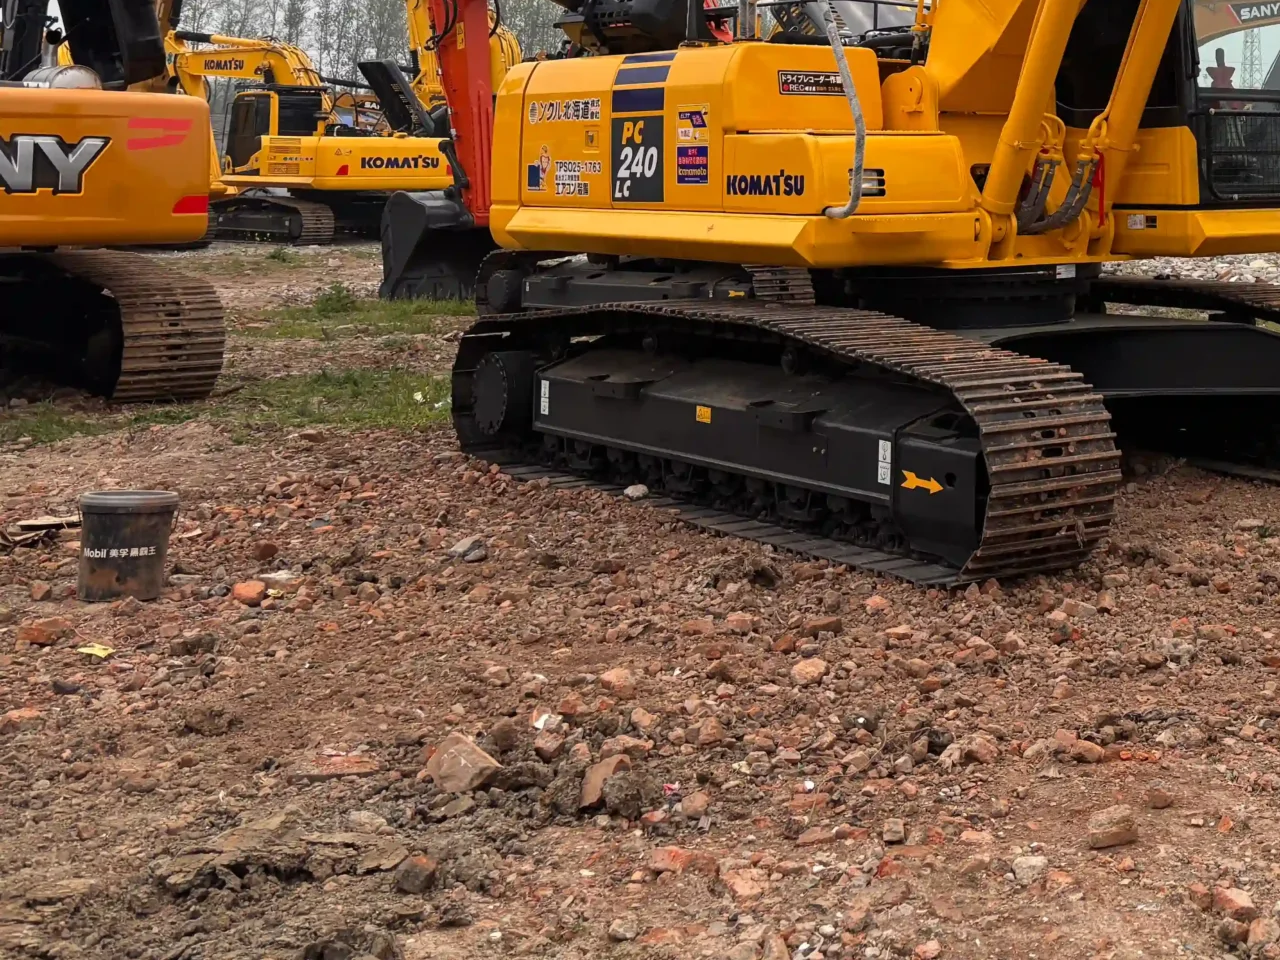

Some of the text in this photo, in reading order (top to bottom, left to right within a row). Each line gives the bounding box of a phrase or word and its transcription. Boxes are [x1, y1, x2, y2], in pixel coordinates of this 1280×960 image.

[1240, 3, 1280, 20] SANY
[204, 57, 244, 71] KOMATSU
[789, 84, 805, 92] REC
[621, 120, 645, 145] PC
[361, 155, 440, 169] KOMATSU
[617, 146, 659, 178] 240
[614, 180, 632, 198] LC
[726, 169, 805, 196] KOMATSU
[83, 547, 107, 558] Mobil
